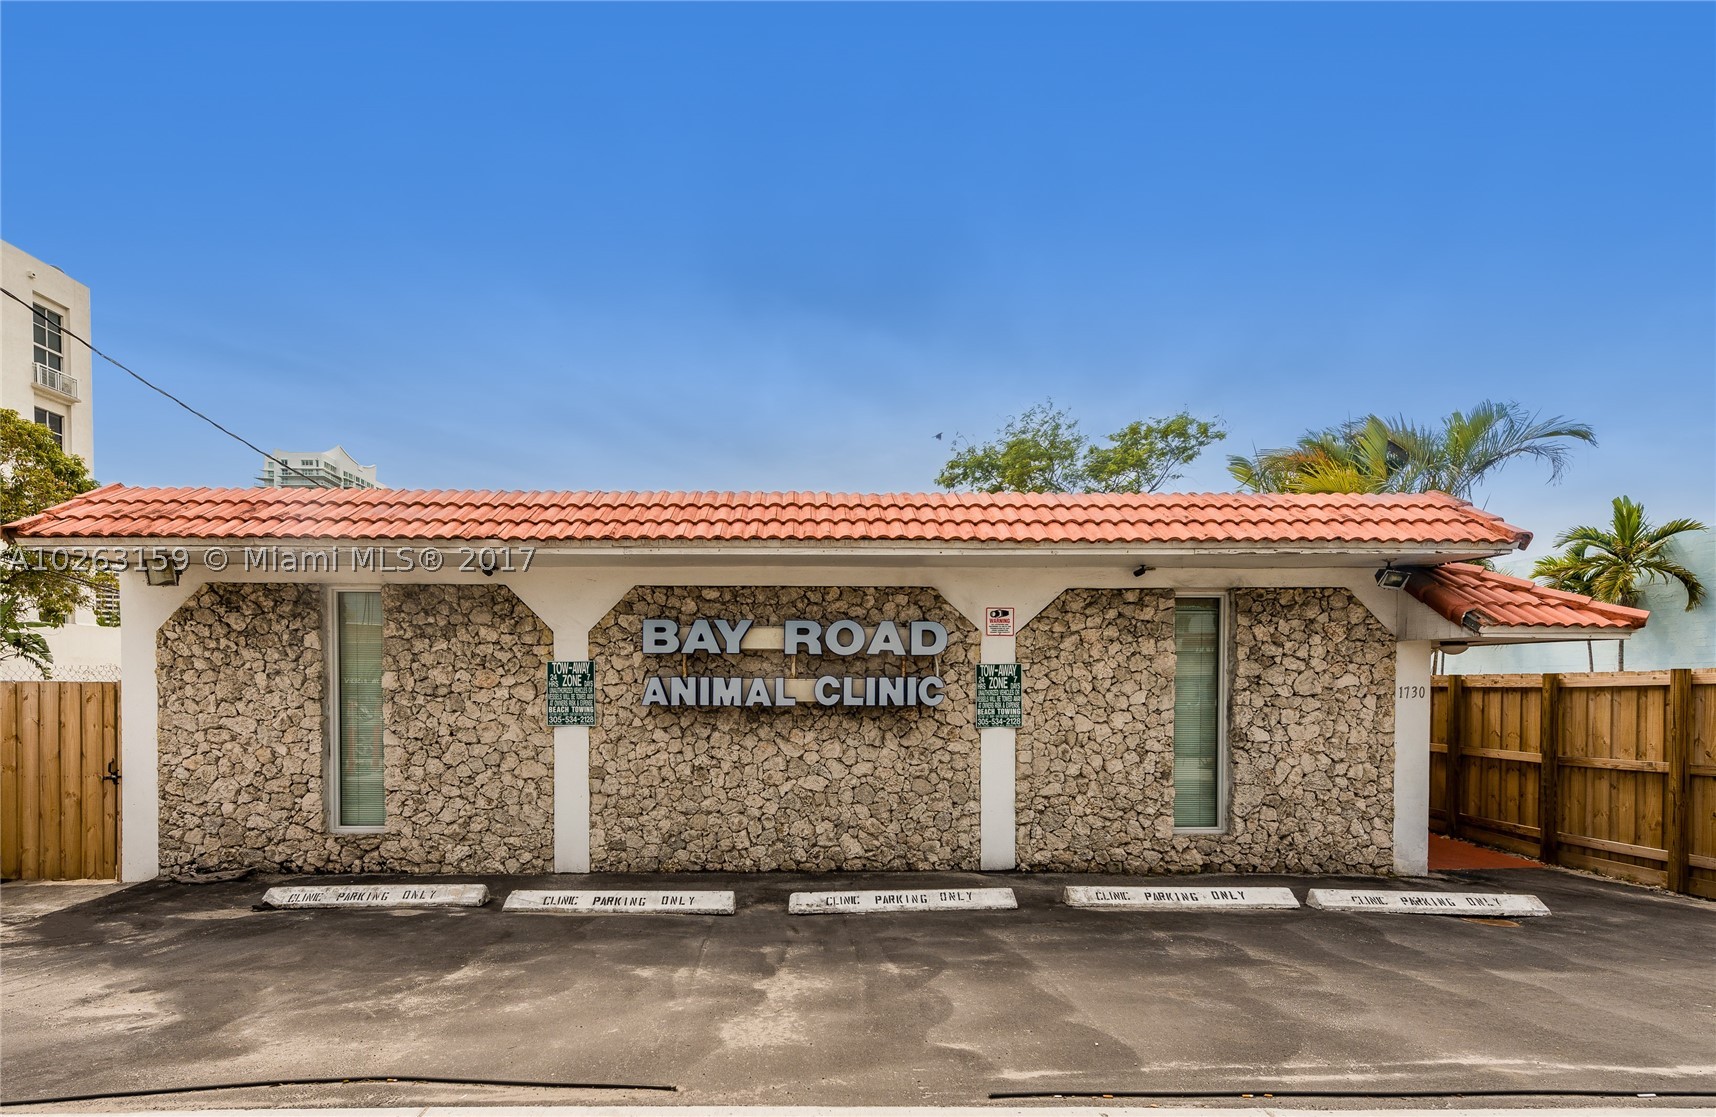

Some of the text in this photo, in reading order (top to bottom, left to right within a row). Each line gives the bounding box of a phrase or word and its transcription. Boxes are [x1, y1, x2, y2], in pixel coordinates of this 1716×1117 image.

[642, 619, 948, 656] BAY ROAD
[552, 662, 590, 674] TOW-AWAY
[980, 664, 1017, 676] TOW-AWAY
[562, 674, 582, 686] ZONE
[988, 676, 1008, 688] ZONE
[641, 675, 945, 706] ANIMAL CLINIC
[1399, 686, 1425, 698] 1730
[287, 890, 437, 902] CLINIC PARKING ONLY
[542, 895, 696, 906] CLINIC PARKING ONLY
[826, 892, 973, 906] CLINIC PARKING ONLY
[1095, 890, 1246, 902] CLINIC PARKING ONLY
[1351, 896, 1502, 907] CLINIC PARKING ONLY
